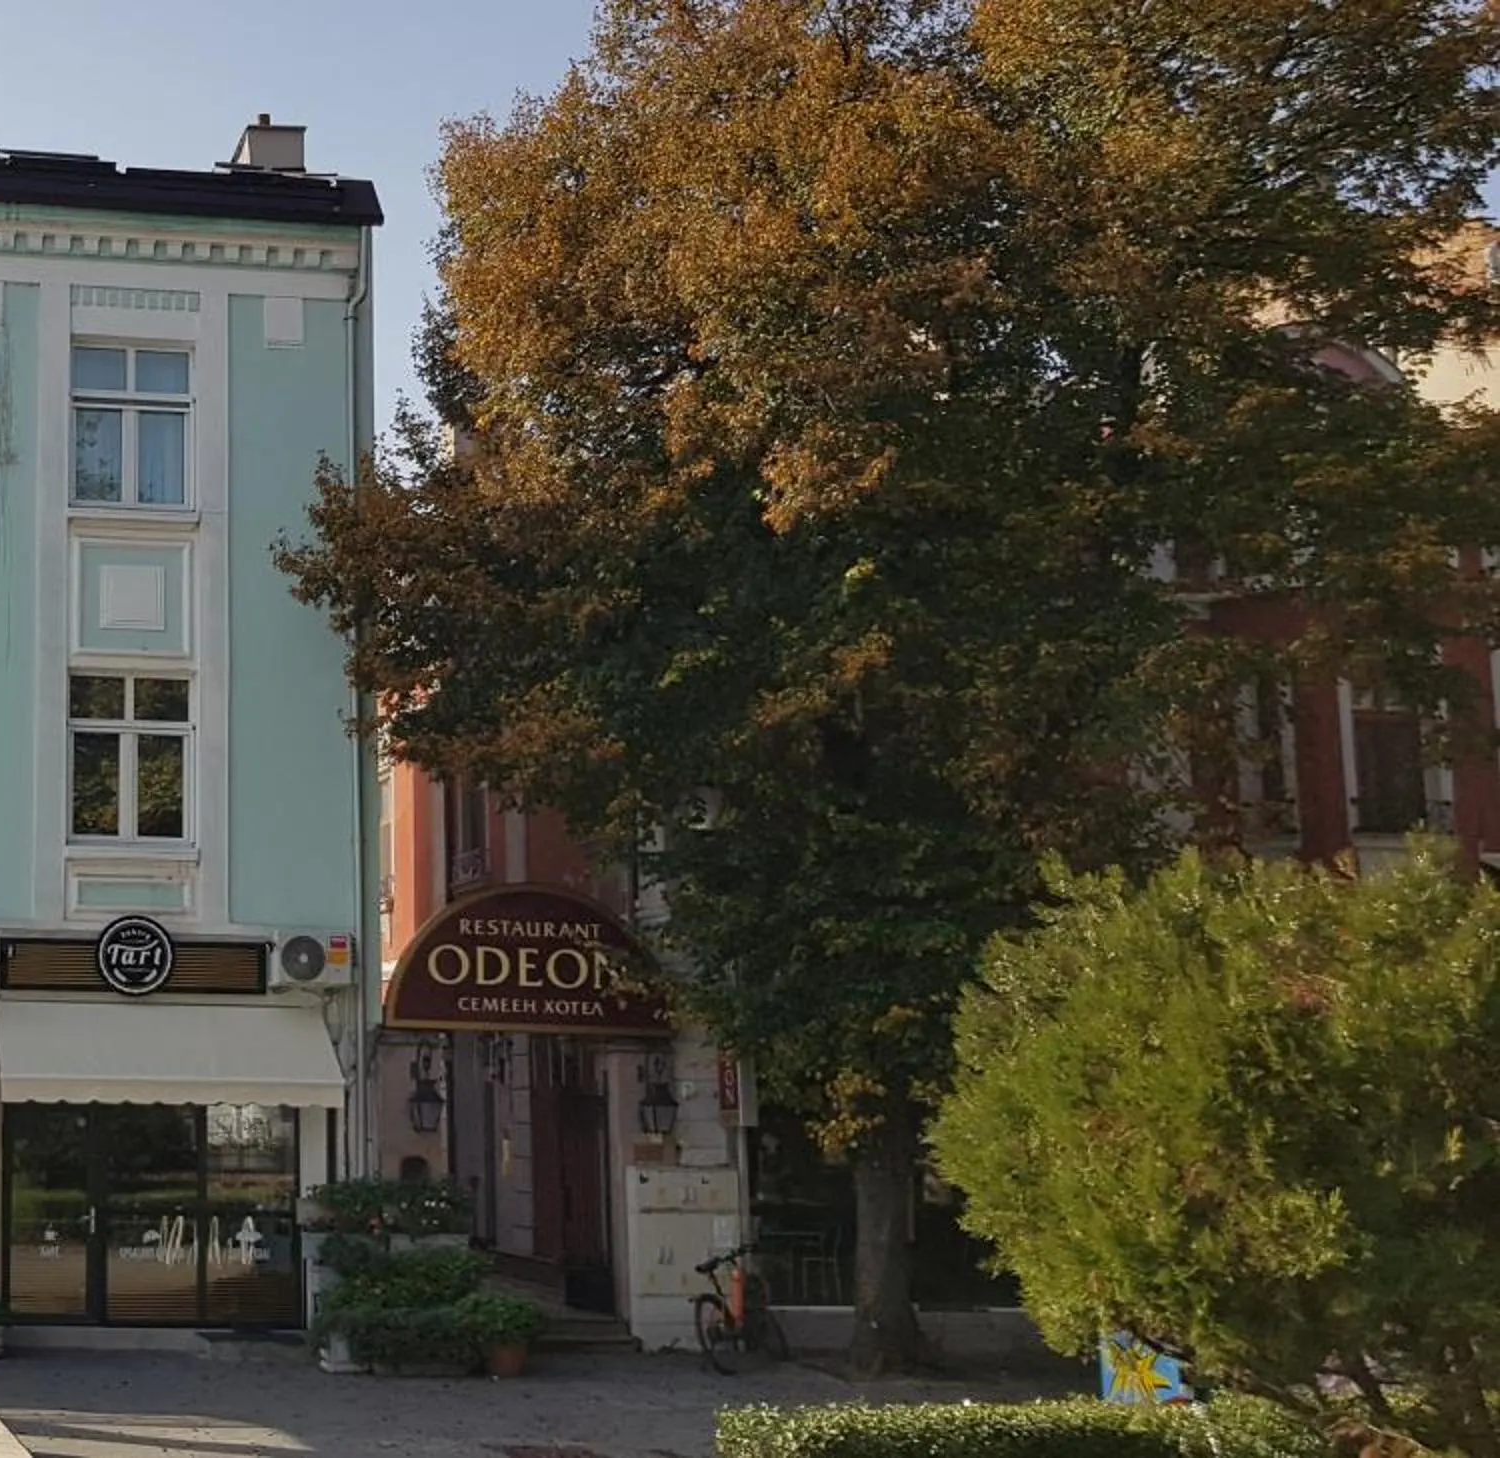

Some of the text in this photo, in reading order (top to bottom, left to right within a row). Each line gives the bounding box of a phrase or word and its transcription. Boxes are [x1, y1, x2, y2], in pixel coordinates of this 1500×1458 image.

[459, 918, 601, 939] RESTAURANT
[107, 940, 161, 965] Tart
[457, 997, 536, 1014] СЕМЕЕН
